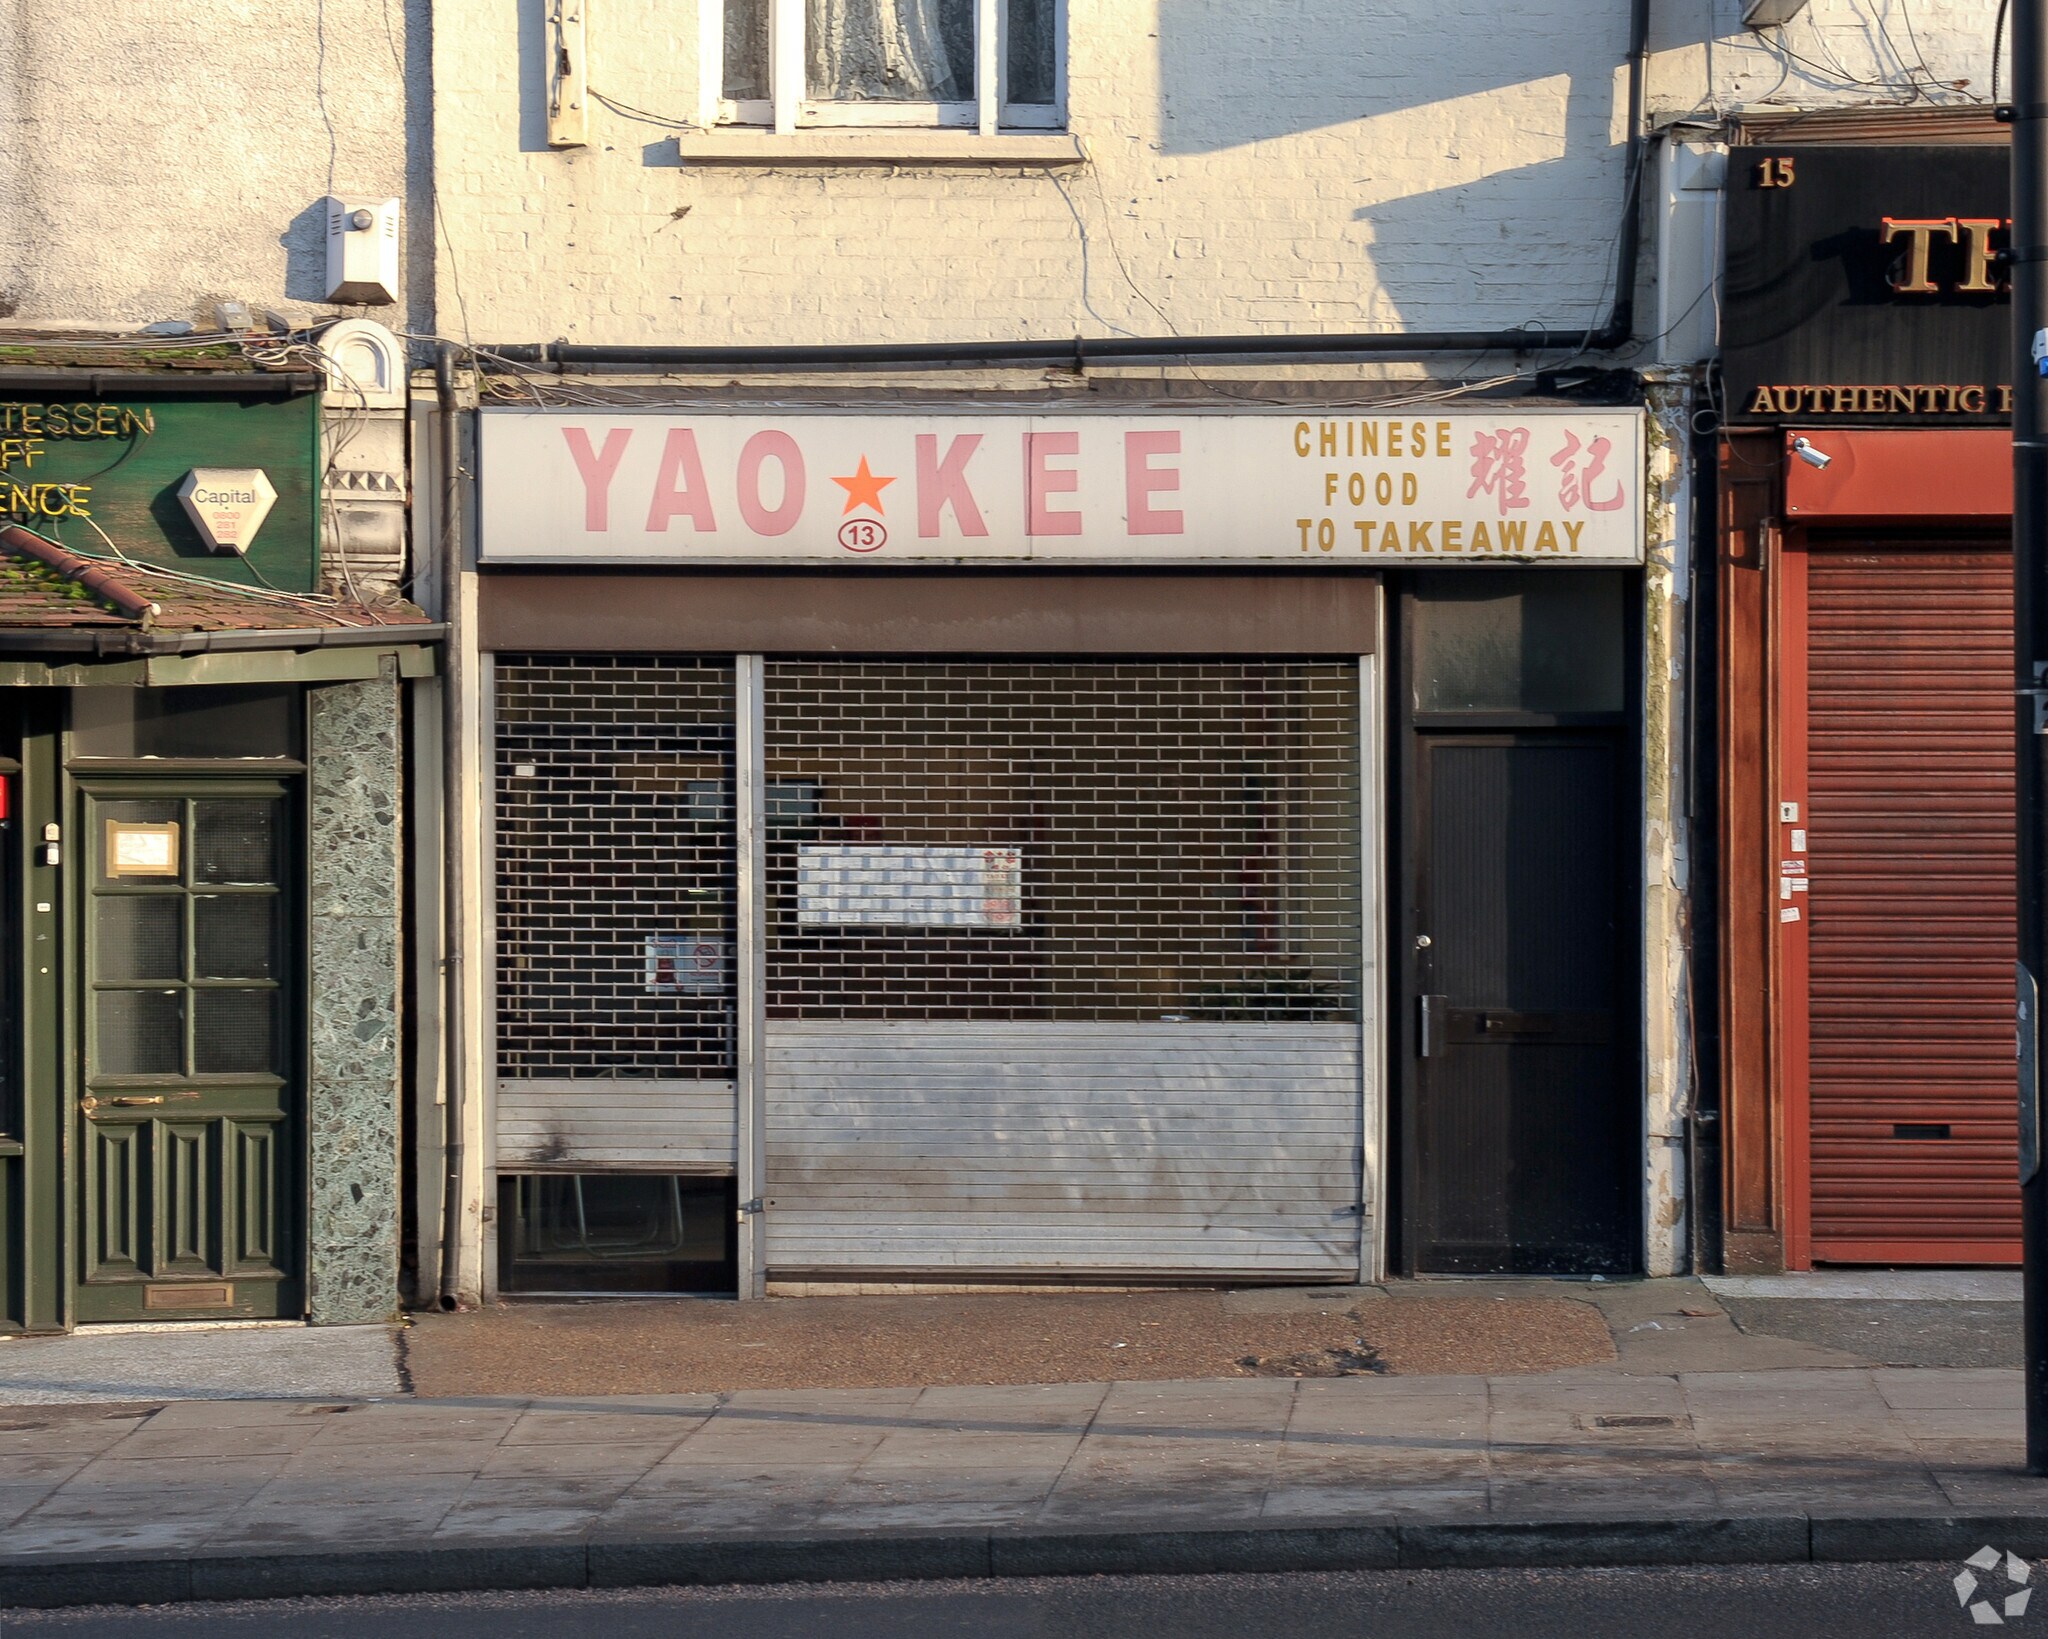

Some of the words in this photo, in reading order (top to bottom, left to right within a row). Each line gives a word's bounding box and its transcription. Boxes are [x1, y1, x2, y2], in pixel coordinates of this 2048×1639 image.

[1759, 157, 1796, 188] 15
[1750, 385, 1986, 414] AUTHENTIC
[1294, 421, 1451, 458] CHINESE
[194, 488, 256, 506] Capital
[561, 427, 806, 537] YAO
[915, 430, 1184, 538] KEE
[1325, 472, 1418, 506] FOOD
[848, 525, 875, 545] 13
[1296, 518, 1335, 552] TO
[1354, 520, 1585, 553] TAKEAWAY
